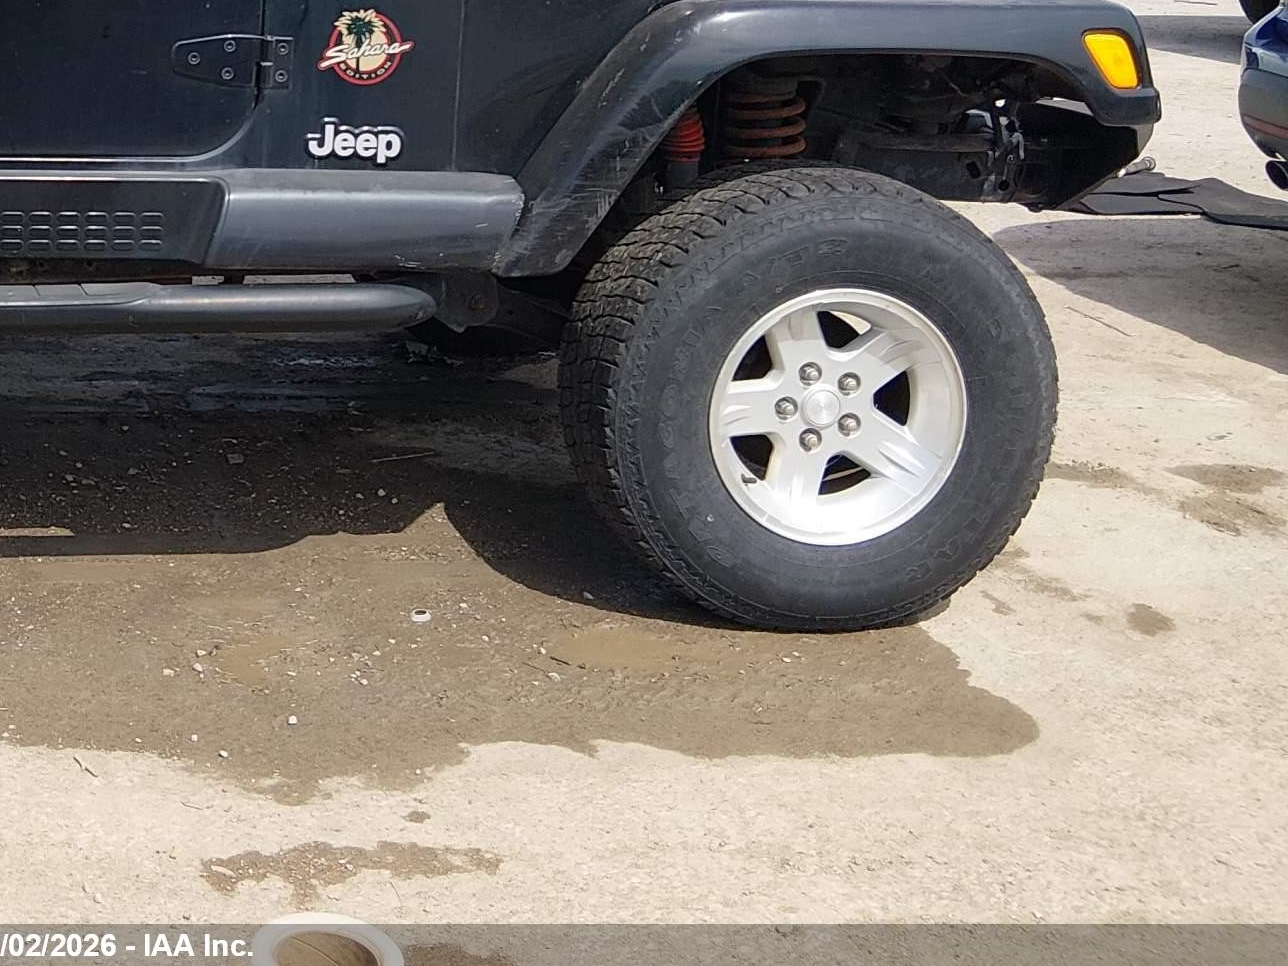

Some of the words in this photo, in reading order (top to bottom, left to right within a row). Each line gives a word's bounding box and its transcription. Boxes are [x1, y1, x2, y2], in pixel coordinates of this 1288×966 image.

[319, 38, 413, 68] Sahara
[338, 61, 394, 79] EDITION
[307, 118, 403, 164] Jeep
